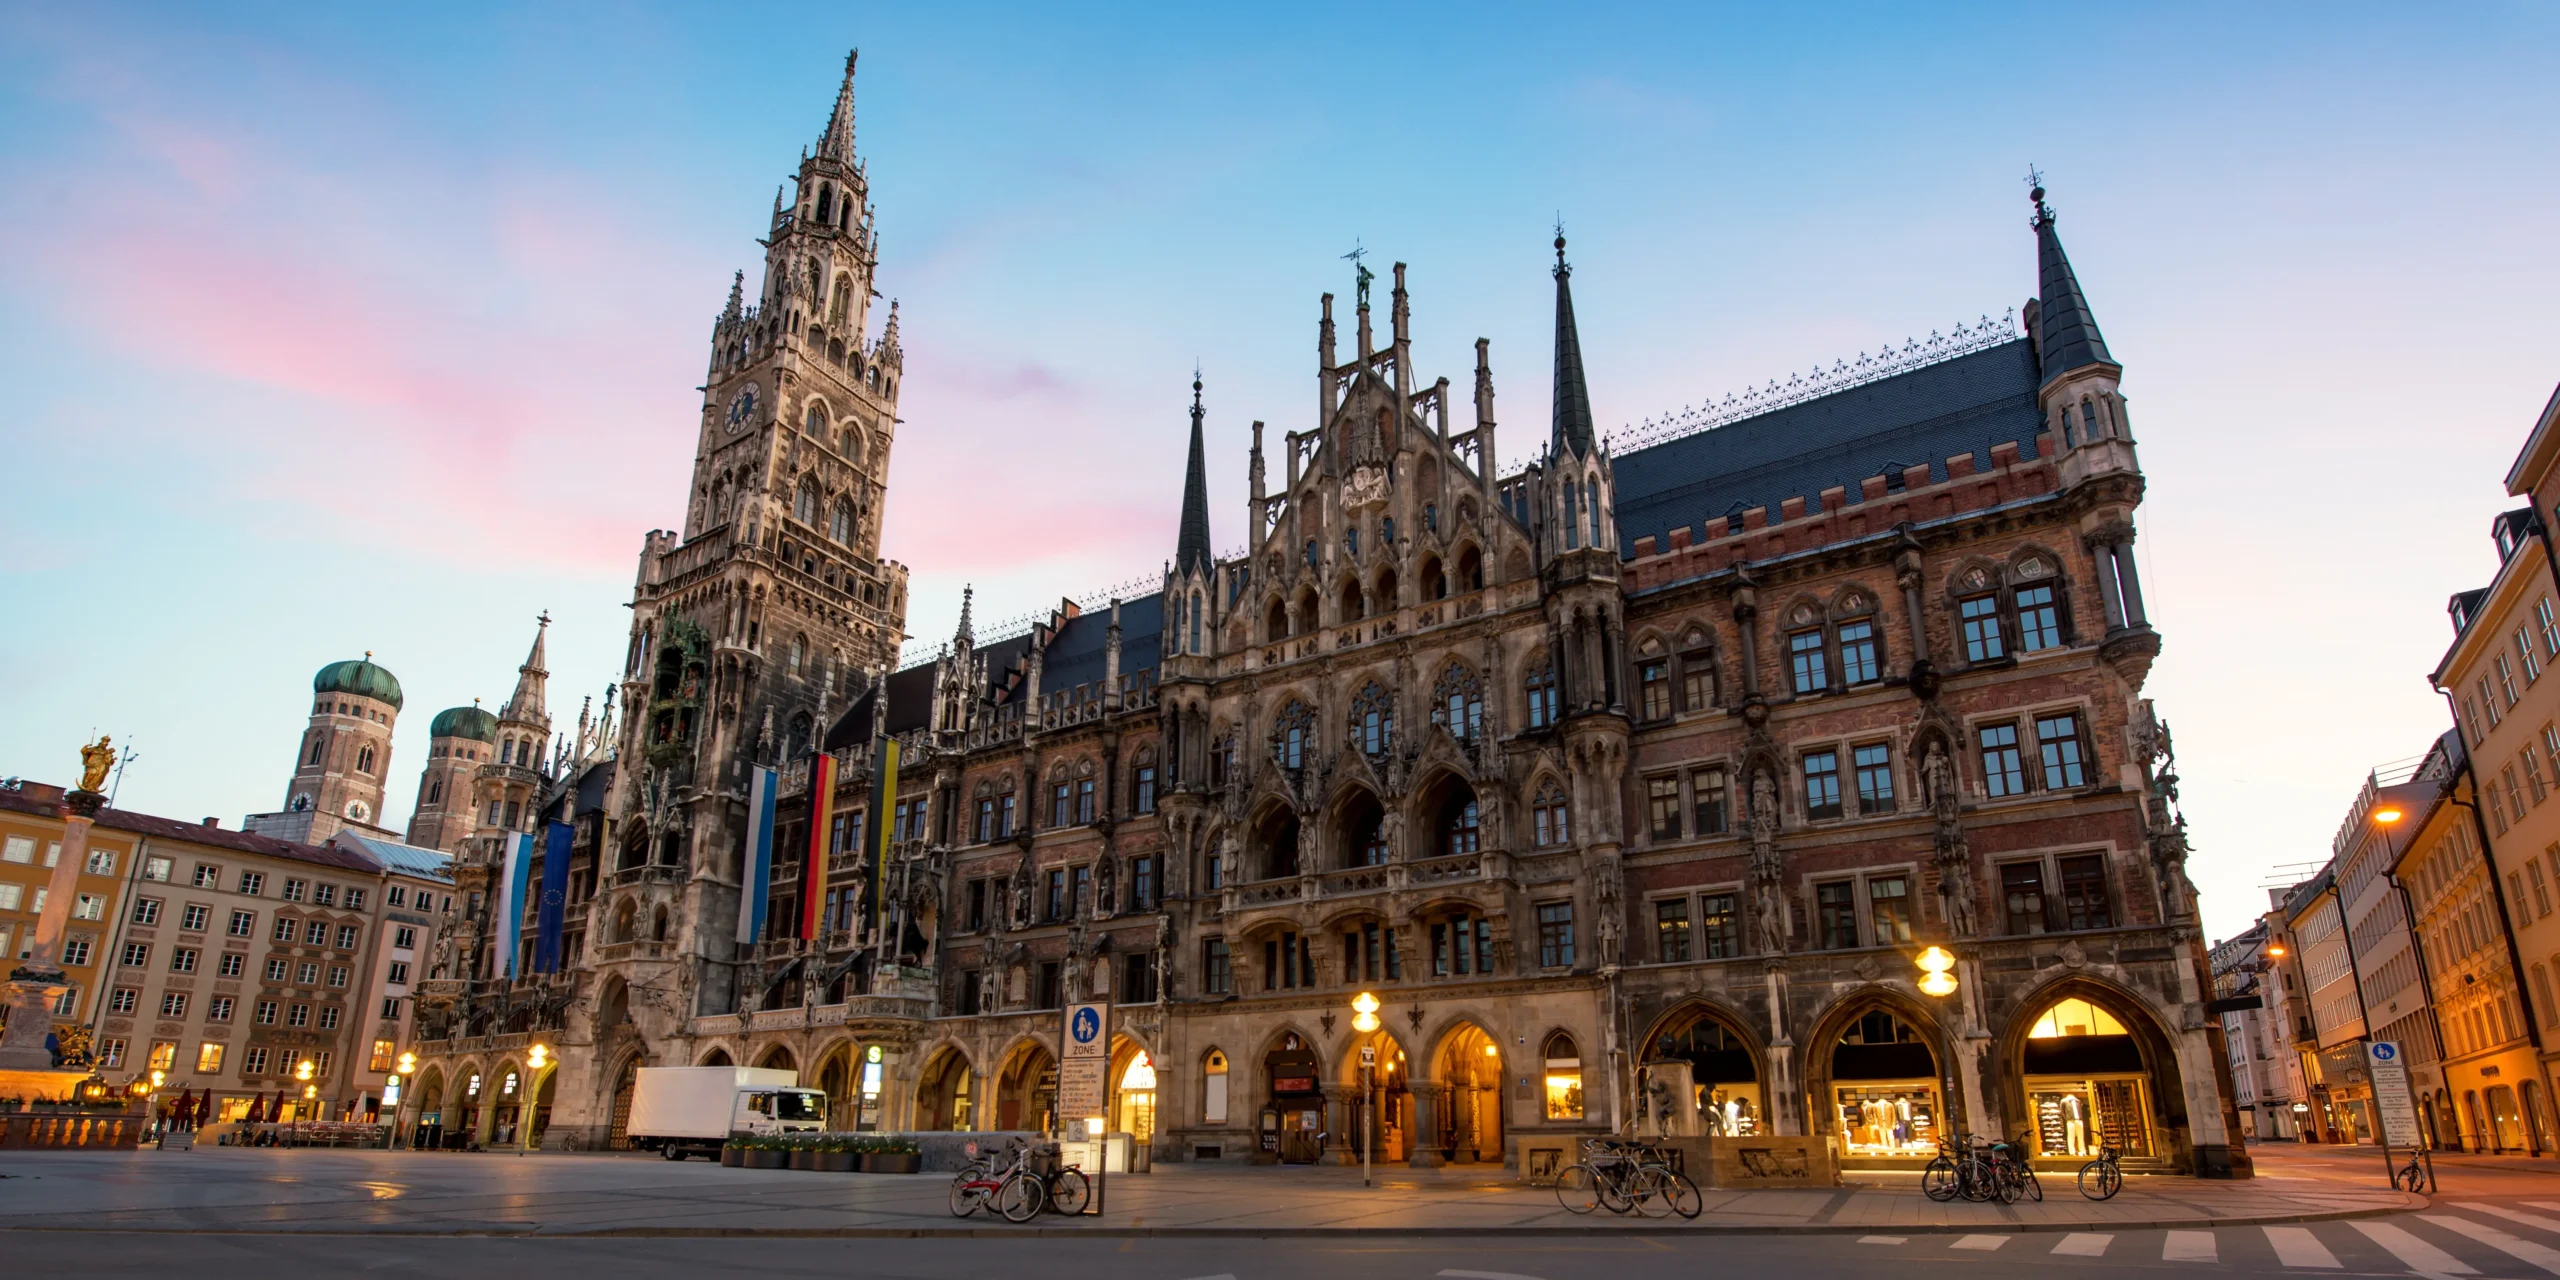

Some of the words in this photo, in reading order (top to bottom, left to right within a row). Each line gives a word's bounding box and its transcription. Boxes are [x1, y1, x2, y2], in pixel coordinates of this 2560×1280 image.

[868, 1046, 881, 1062] S
[1073, 1045, 1095, 1055] ZONE
[388, 1075, 399, 1086] S
